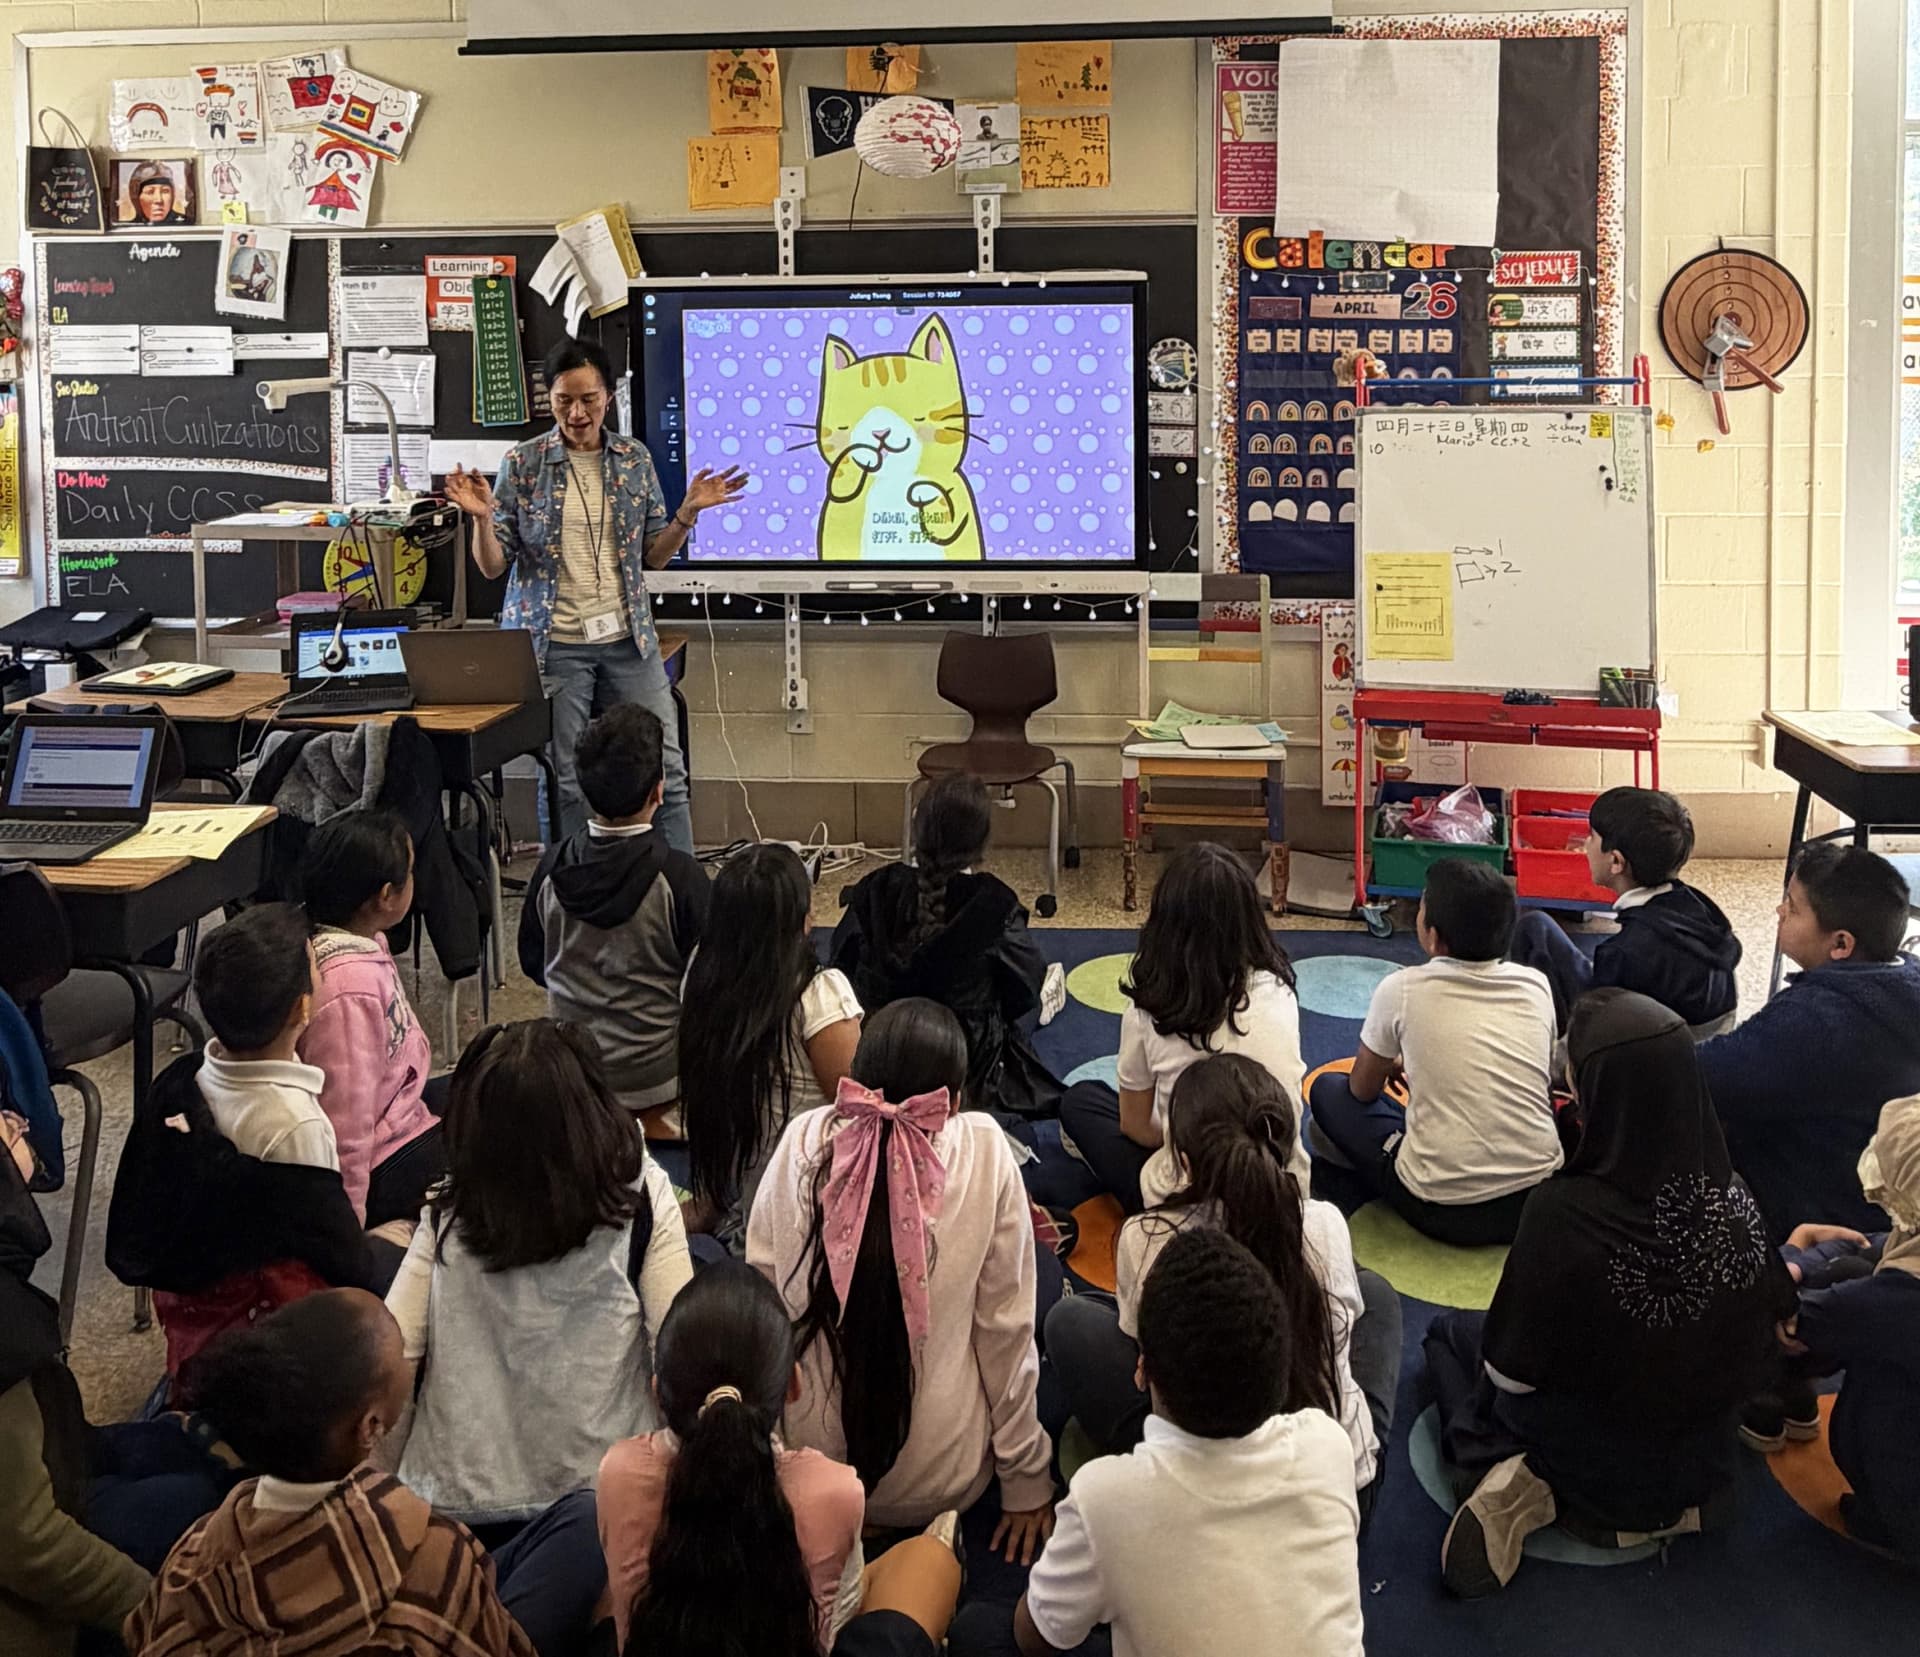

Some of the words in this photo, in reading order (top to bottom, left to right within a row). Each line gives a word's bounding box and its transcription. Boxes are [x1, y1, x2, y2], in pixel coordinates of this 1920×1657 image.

[129, 243, 180, 262] Agenda
[1242, 226, 1457, 269] Calendar
[432, 260, 489, 273] Learning
[1501, 258, 1574, 280] SCHEDULE
[1333, 301, 1379, 315] APRIL
[1402, 281, 1458, 320] 26
[441, 304, 469, 318] 学习
[1527, 303, 1550, 316] 中文
[1311, 408, 1319, 418] 7
[1254, 441, 1265, 452] 12
[1280, 441, 1291, 452] 13
[1342, 441, 1353, 452] 15
[58, 471, 75, 489] Do
[1283, 474, 1298, 485] 20
[1, 476, 13, 532] Sentence
[66, 485, 154, 535] Daily
[401, 543, 412, 556] 2
[61, 552, 119, 572] Homework
[66, 572, 131, 597] ELA
[400, 581, 409, 595] 4
